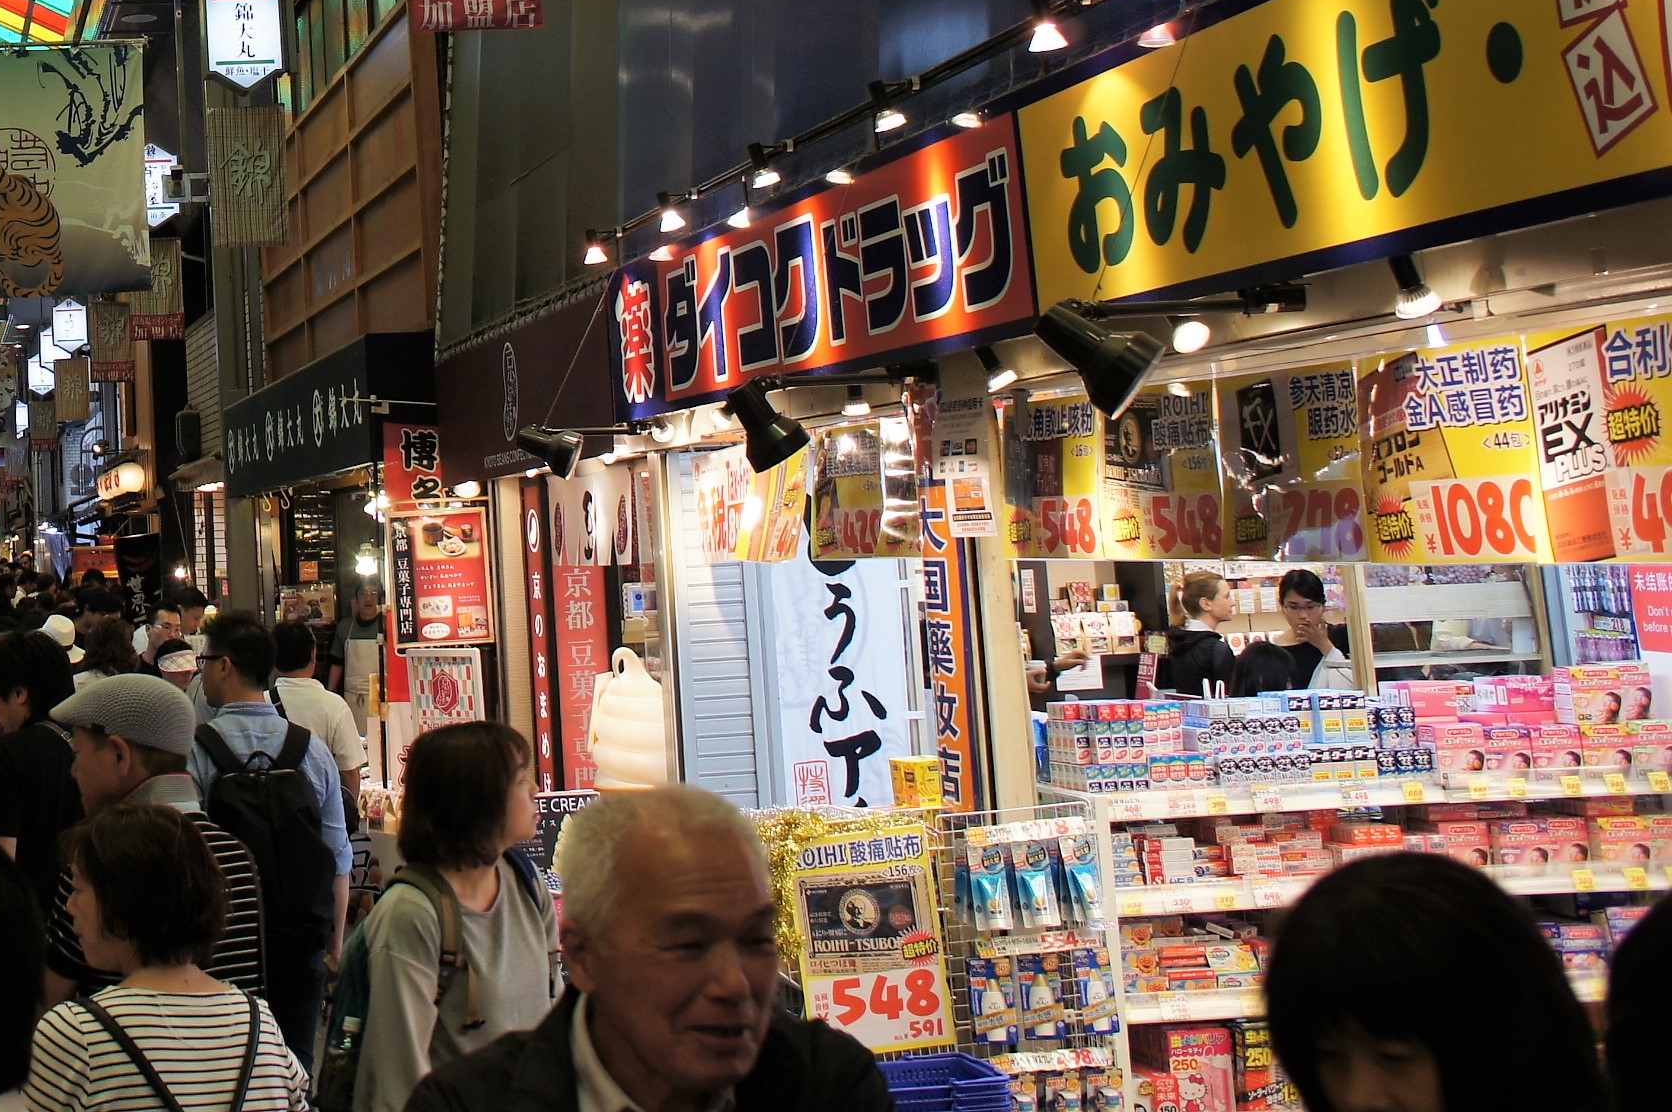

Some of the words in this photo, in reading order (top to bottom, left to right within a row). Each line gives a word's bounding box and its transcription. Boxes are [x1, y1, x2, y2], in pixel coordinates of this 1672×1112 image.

[221, 143, 272, 206] 錦
[665, 147, 1014, 392] ダイコクドラッグ
[135, 326, 182, 339] 加盟店
[616, 281, 655, 404] 薬
[1416, 348, 1518, 391] 大正制药
[1605, 324, 1672, 379] 合利
[328, 378, 362, 437] 錦大丸
[1164, 393, 1208, 418] ROIHI
[1290, 372, 1355, 410] 参天清凉
[1404, 386, 1525, 428] 金A感冒药
[1537, 390, 1591, 426] アリナミン
[1153, 418, 1208, 448] 酸痛贴布
[1307, 409, 1356, 439] 眼药水
[1541, 412, 1595, 464] EX
[1608, 405, 1658, 441] 超特价
[1554, 443, 1607, 482] PLUS
[393, 520, 409, 552] 京都
[1041, 499, 1097, 554] 548
[1152, 493, 1222, 554] 548
[1378, 513, 1413, 542] 超特价
[1431, 479, 1536, 556] 1080
[1619, 528, 1633, 552] ¥
[396, 557, 413, 635] 豆菓子専門店
[562, 568, 595, 630] 京都
[1647, 605, 1669, 617] Don't
[1643, 622, 1668, 633] before
[849, 835, 922, 866] 酸痛贴布
[902, 937, 939, 960] 超特价
[1041, 930, 1079, 950] 554
[832, 969, 941, 1027] 548
[909, 1017, 945, 1039] 591
[1246, 1047, 1272, 1067] 250
